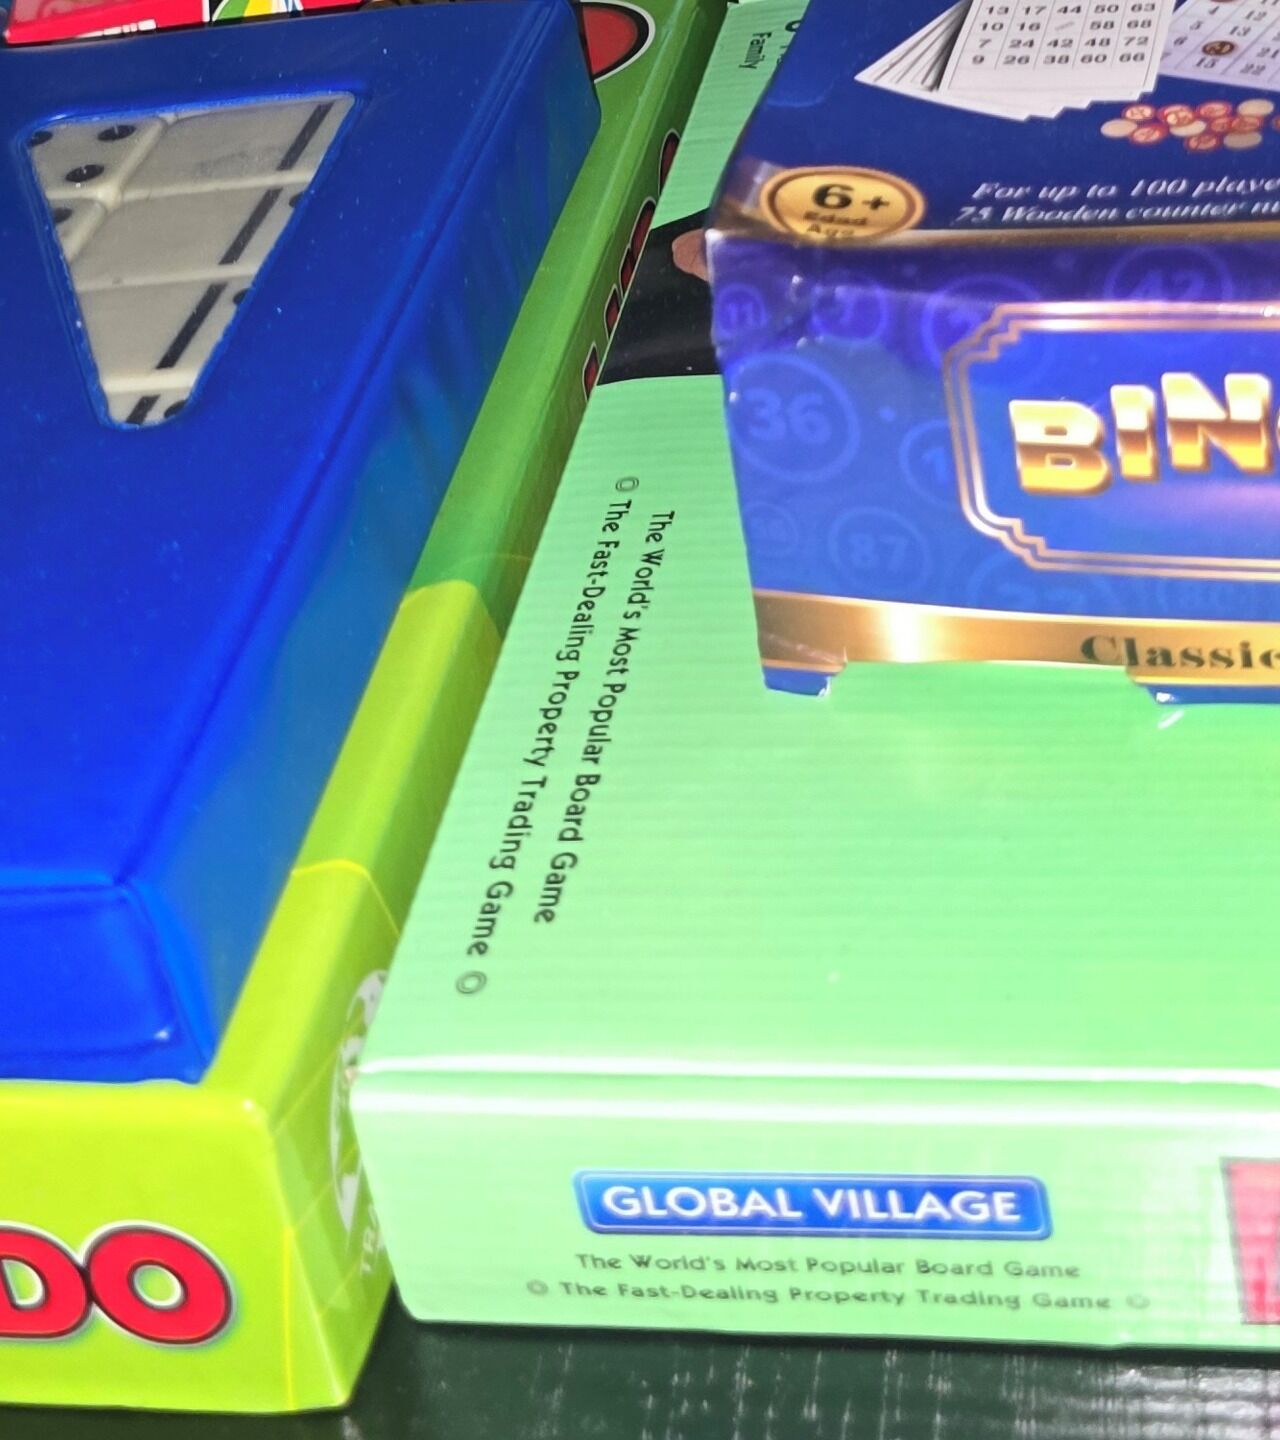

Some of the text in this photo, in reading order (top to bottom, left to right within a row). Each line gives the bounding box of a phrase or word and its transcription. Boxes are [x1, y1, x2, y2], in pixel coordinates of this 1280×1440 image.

[739, 32, 772, 69] Family
[812, 184, 890, 210] 6+
[972, 182, 1030, 200] For
[1038, 185, 1080, 202] up
[1087, 182, 1118, 199] to
[1130, 177, 1186, 197] 100
[1000, 204, 1119, 223] Wooden
[1125, 200, 1242, 221] counter
[742, 388, 831, 445] 36
[466, 499, 632, 957] The Fast-Dealing Property Trading Game
[534, 509, 676, 924] The World's Most Popular Board Game
[601, 1185, 1021, 1223] GLOBAL VILLAGE
[575, 1253, 1081, 1279] The World's Most Popular Board Game
[560, 1280, 1111, 1311] The Fast-Dealing Property Trading Game
